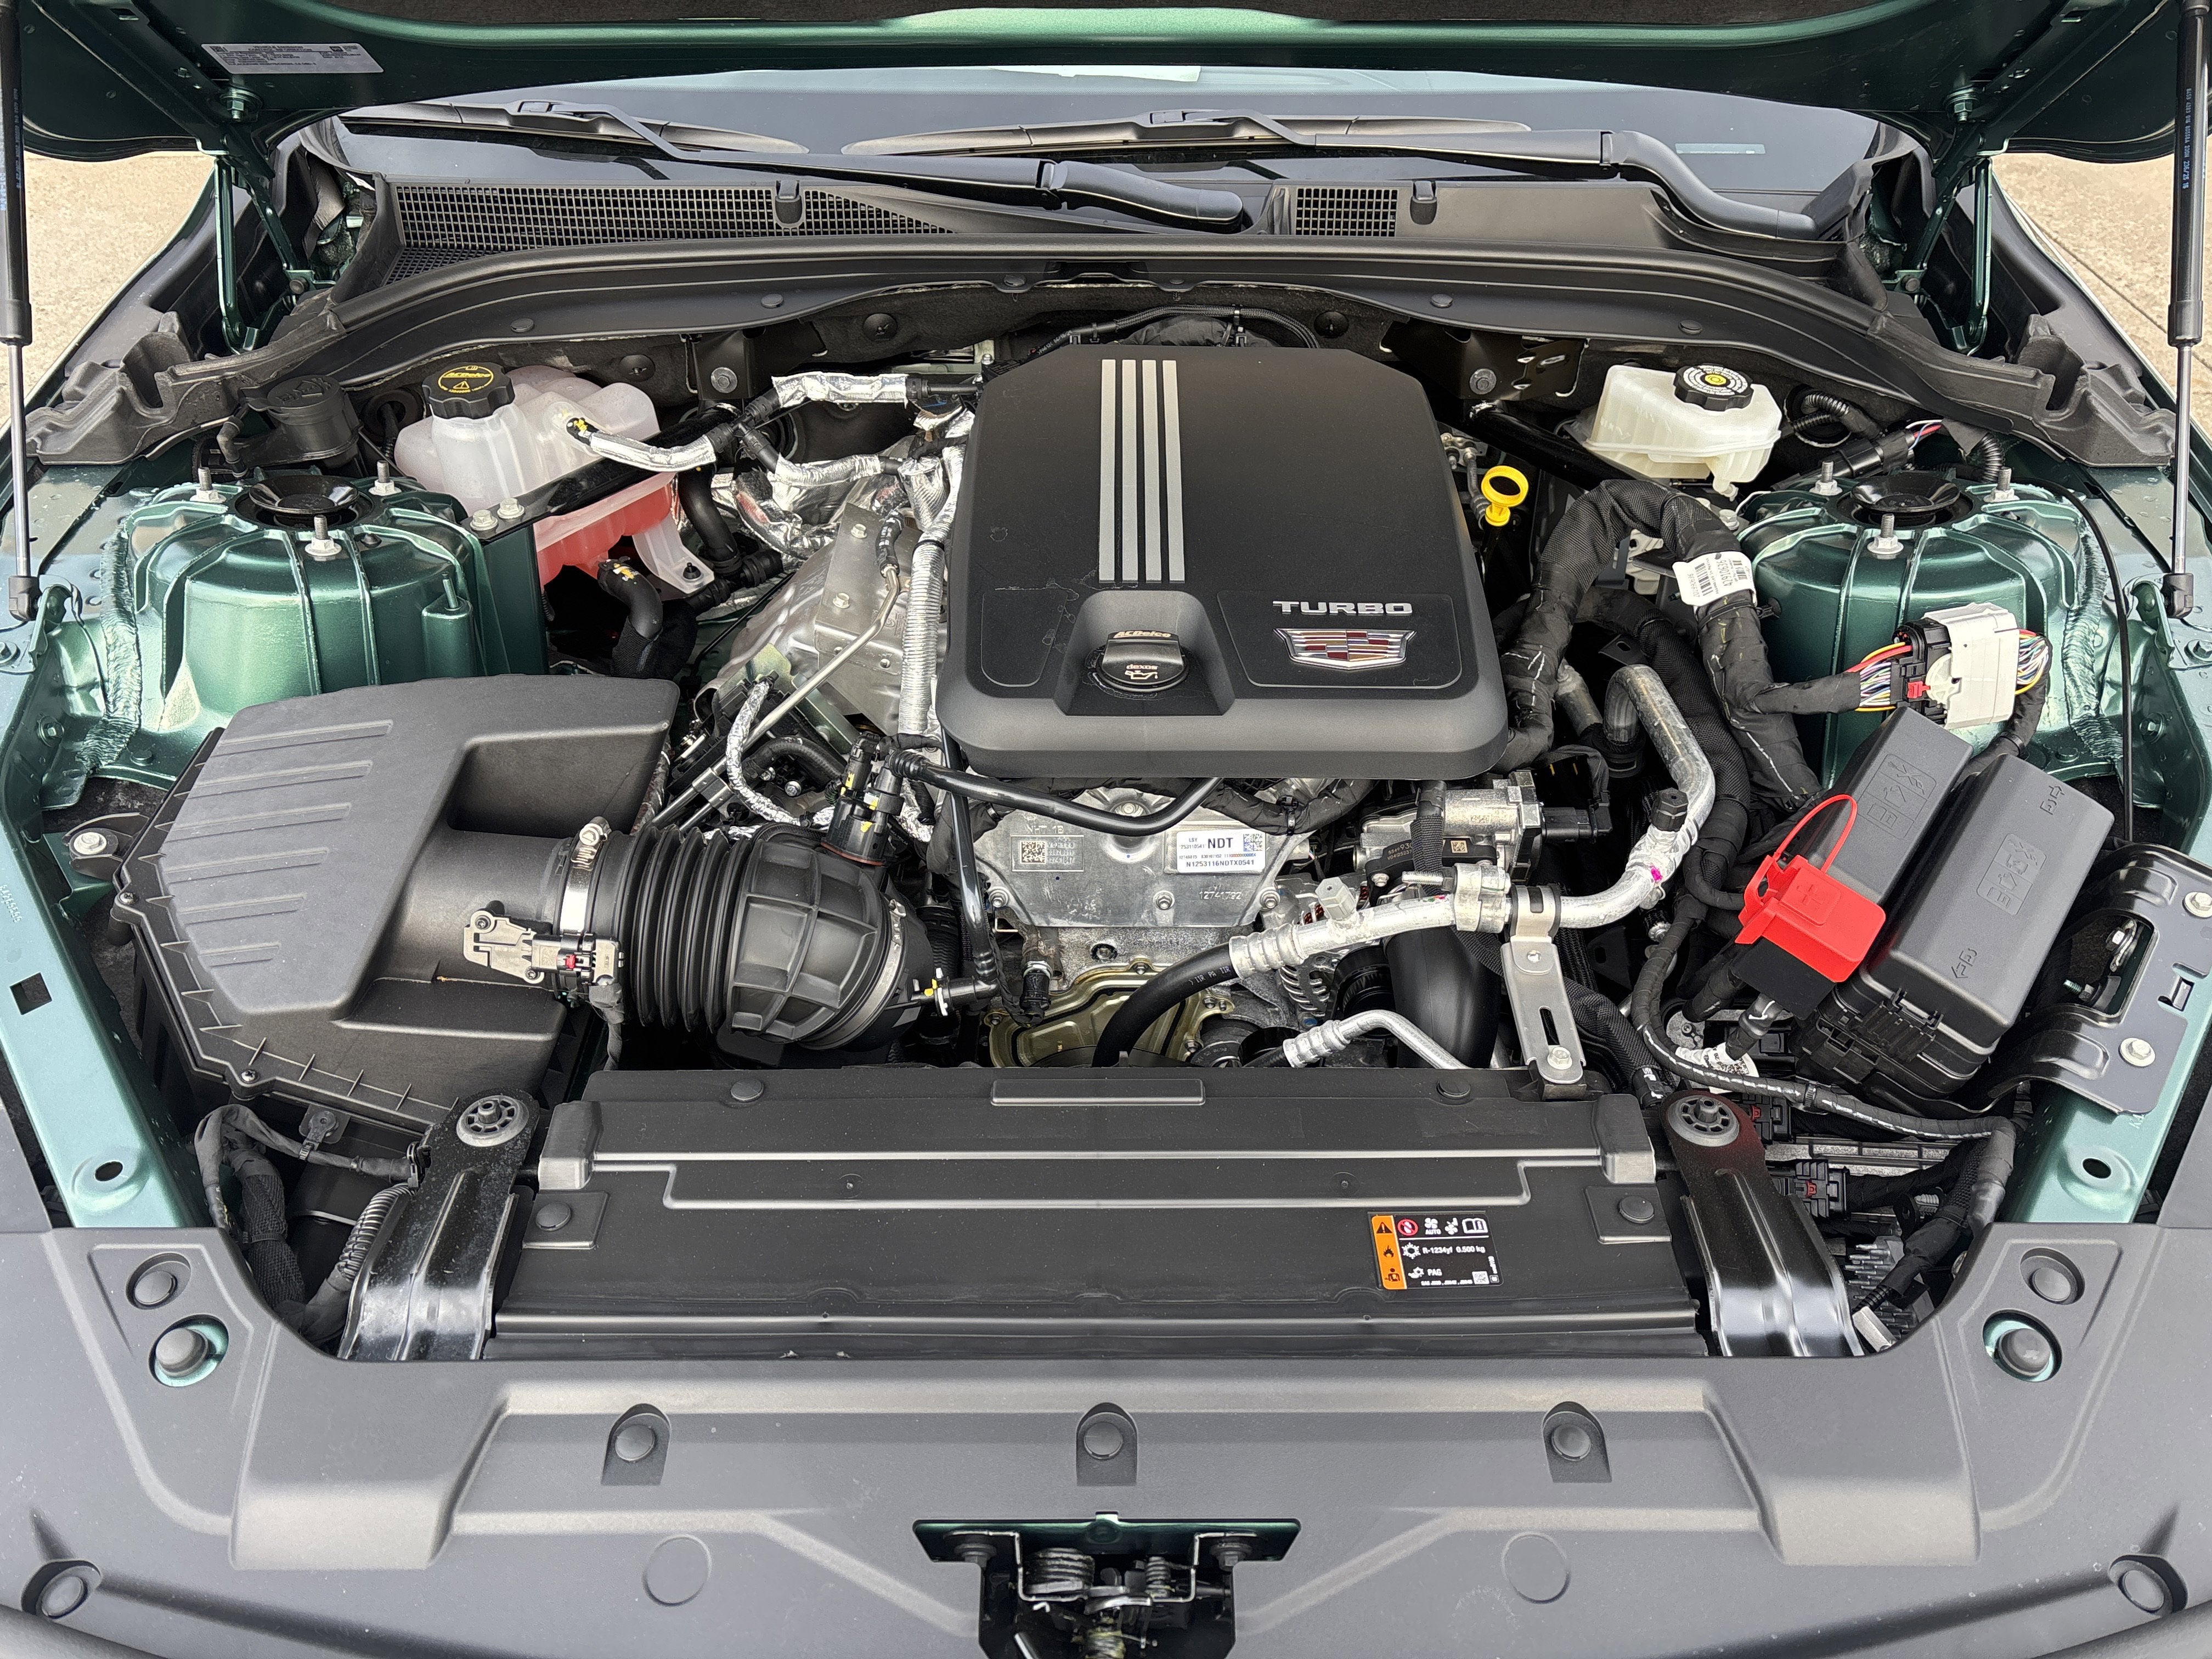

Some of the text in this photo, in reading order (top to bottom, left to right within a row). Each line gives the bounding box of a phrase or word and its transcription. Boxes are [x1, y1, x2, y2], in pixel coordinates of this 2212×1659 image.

[1716, 559, 1734, 587] 42910636
[1272, 601, 1413, 615] TURBO
[1207, 838, 1233, 849] NDT
[1427, 1268, 1442, 1277] PAG
